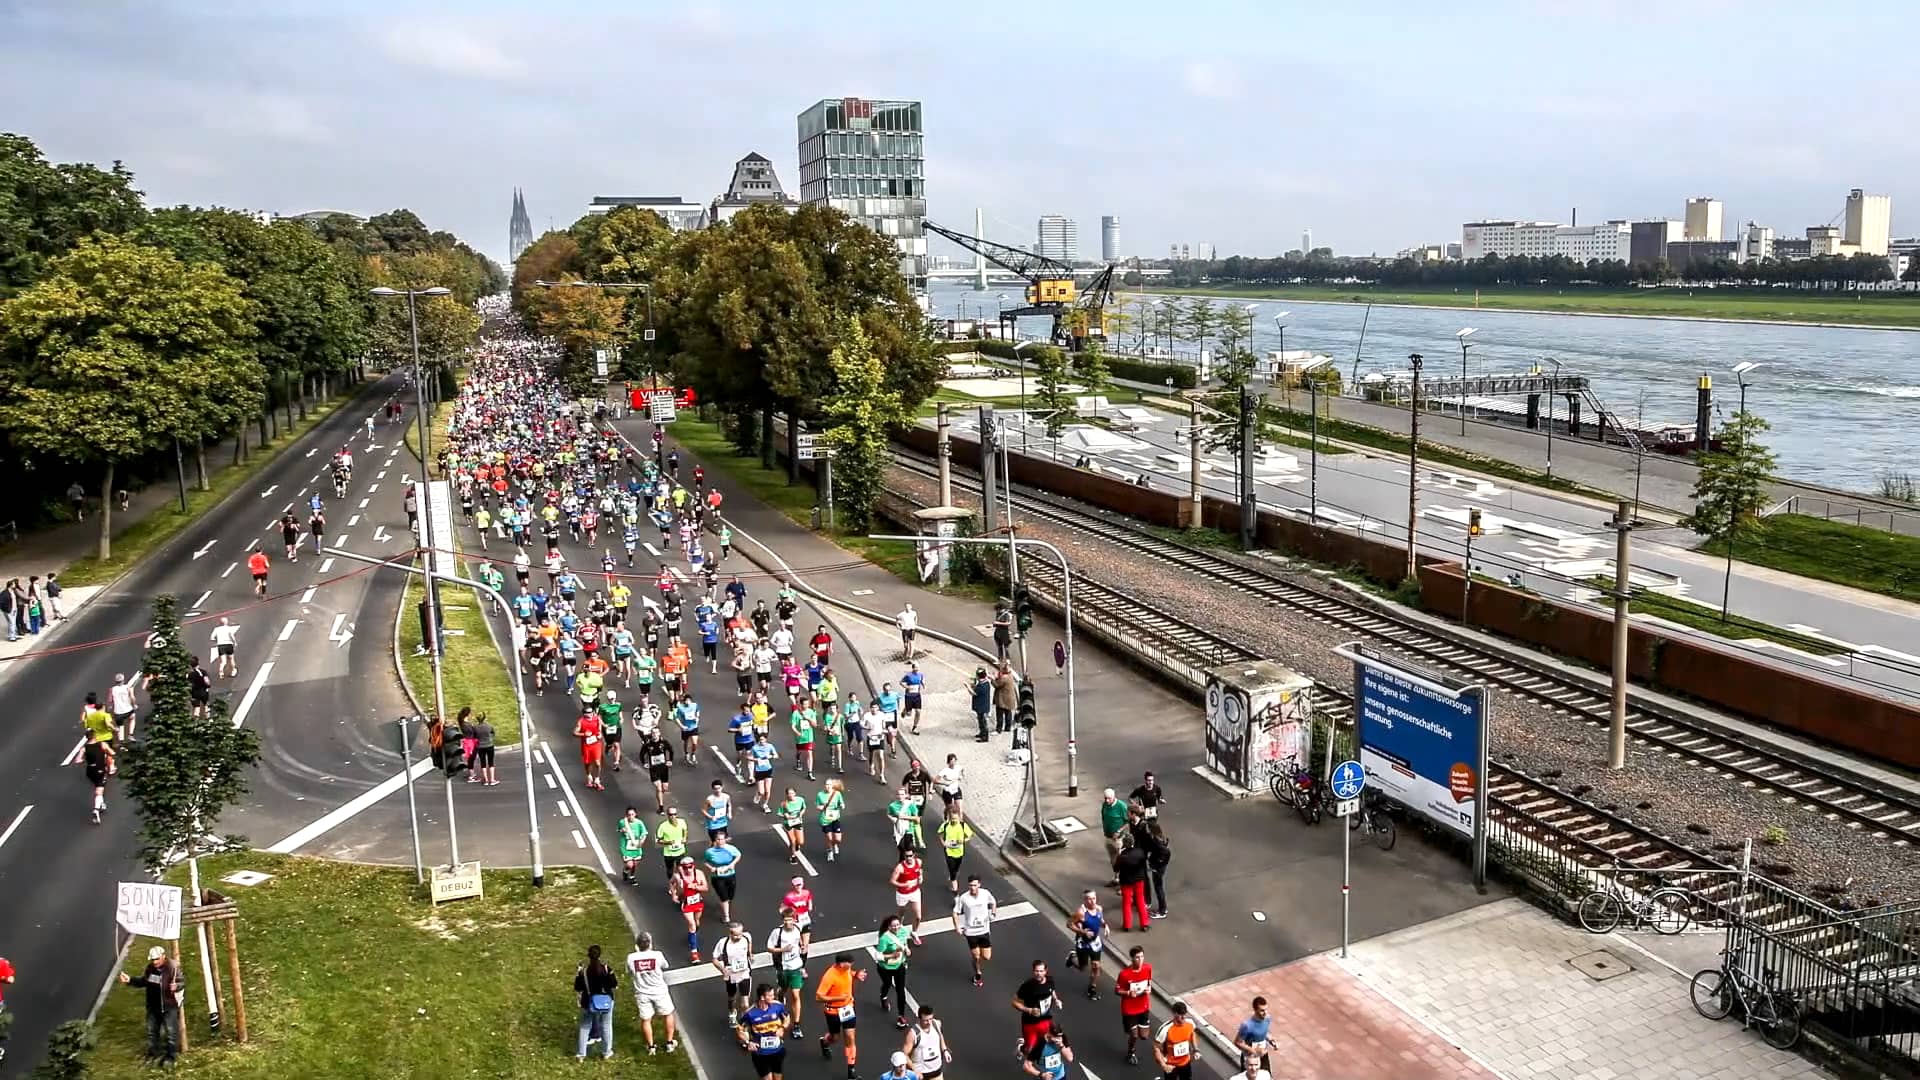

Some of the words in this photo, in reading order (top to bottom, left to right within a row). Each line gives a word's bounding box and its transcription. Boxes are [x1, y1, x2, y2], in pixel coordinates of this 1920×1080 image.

[1365, 677, 1377, 690] Ihre
[1378, 684, 1398, 698] eigene
[1399, 690, 1410, 703] ist:
[1364, 696, 1386, 711] unsere
[1386, 705, 1453, 739] genossenschaftliche
[1364, 707, 1394, 729] Beratung.
